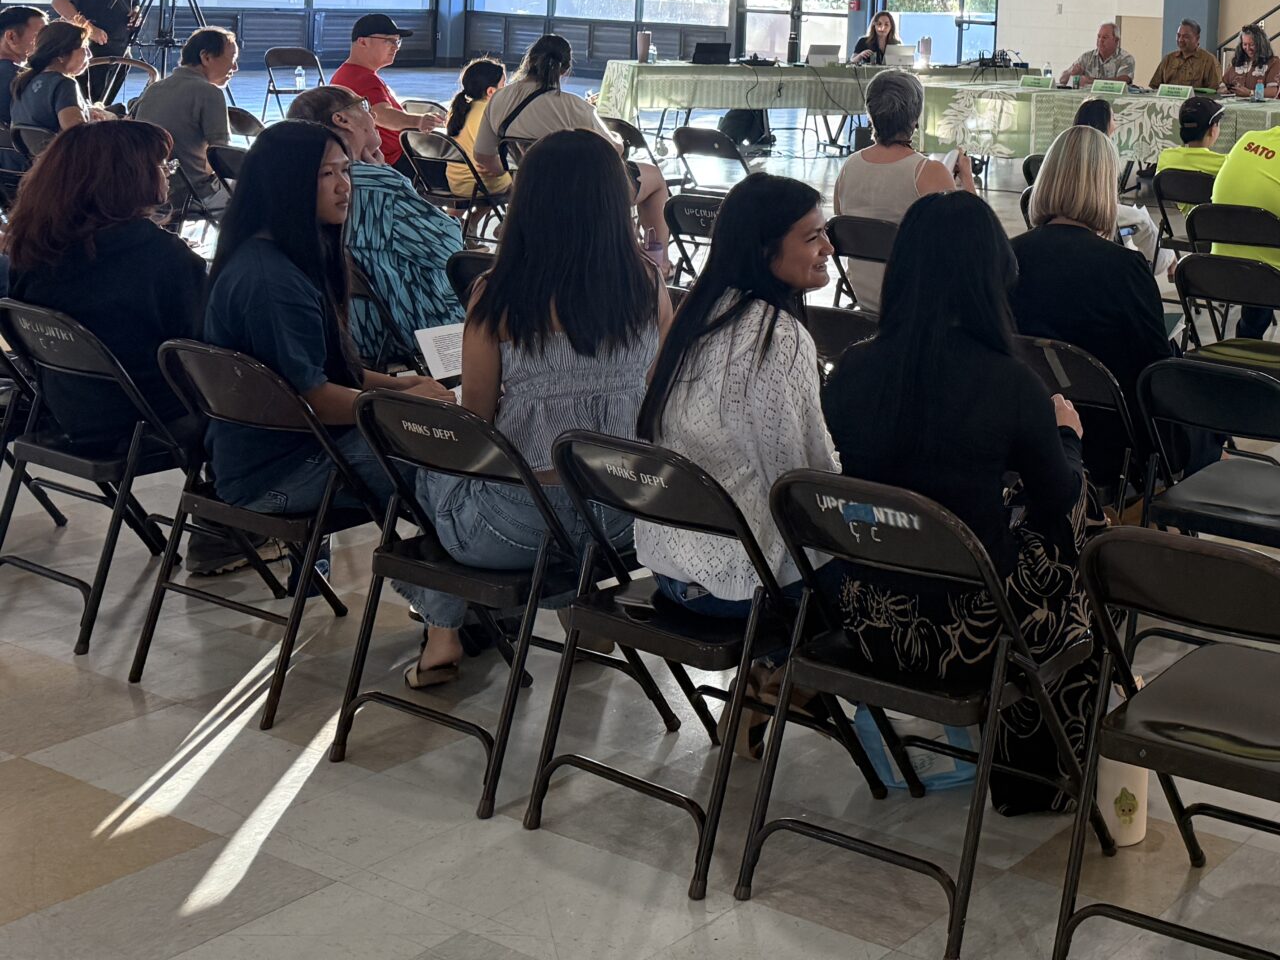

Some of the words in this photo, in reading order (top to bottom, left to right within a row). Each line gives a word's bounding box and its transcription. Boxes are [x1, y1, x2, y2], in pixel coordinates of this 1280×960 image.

[1243, 141, 1276, 160] SATO
[401, 420, 431, 436] PARKS
[432, 427, 459, 442] DEPT.
[605, 463, 637, 482] PARKS
[640, 472, 668, 489] DEPT.
[816, 493, 920, 530] UPCNTRY
